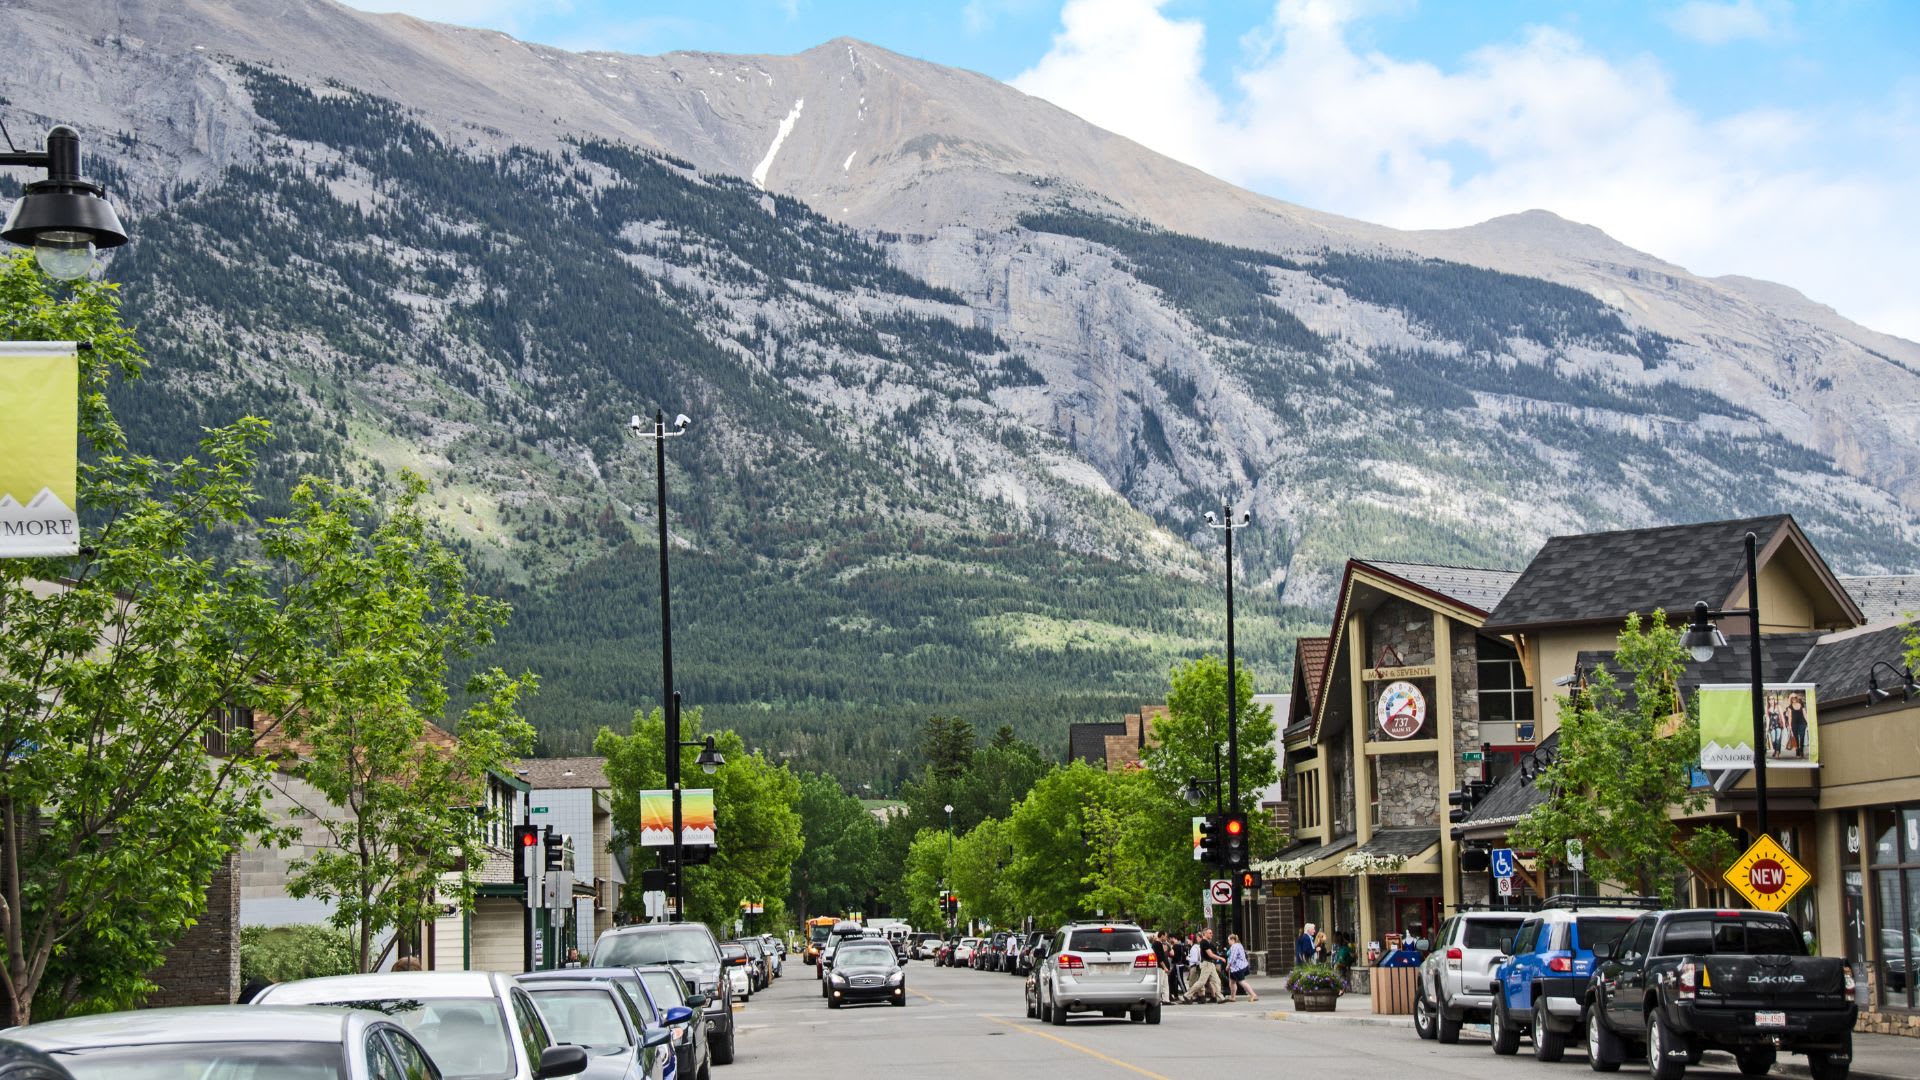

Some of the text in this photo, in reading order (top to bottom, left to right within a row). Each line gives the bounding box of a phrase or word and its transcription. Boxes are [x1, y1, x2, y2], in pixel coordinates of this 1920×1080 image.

[1397, 667, 1430, 677] SEVENTH
[1394, 718, 1409, 727] 737
[1751, 868, 1783, 885] NEW
[1747, 973, 1806, 984] DAKINE
